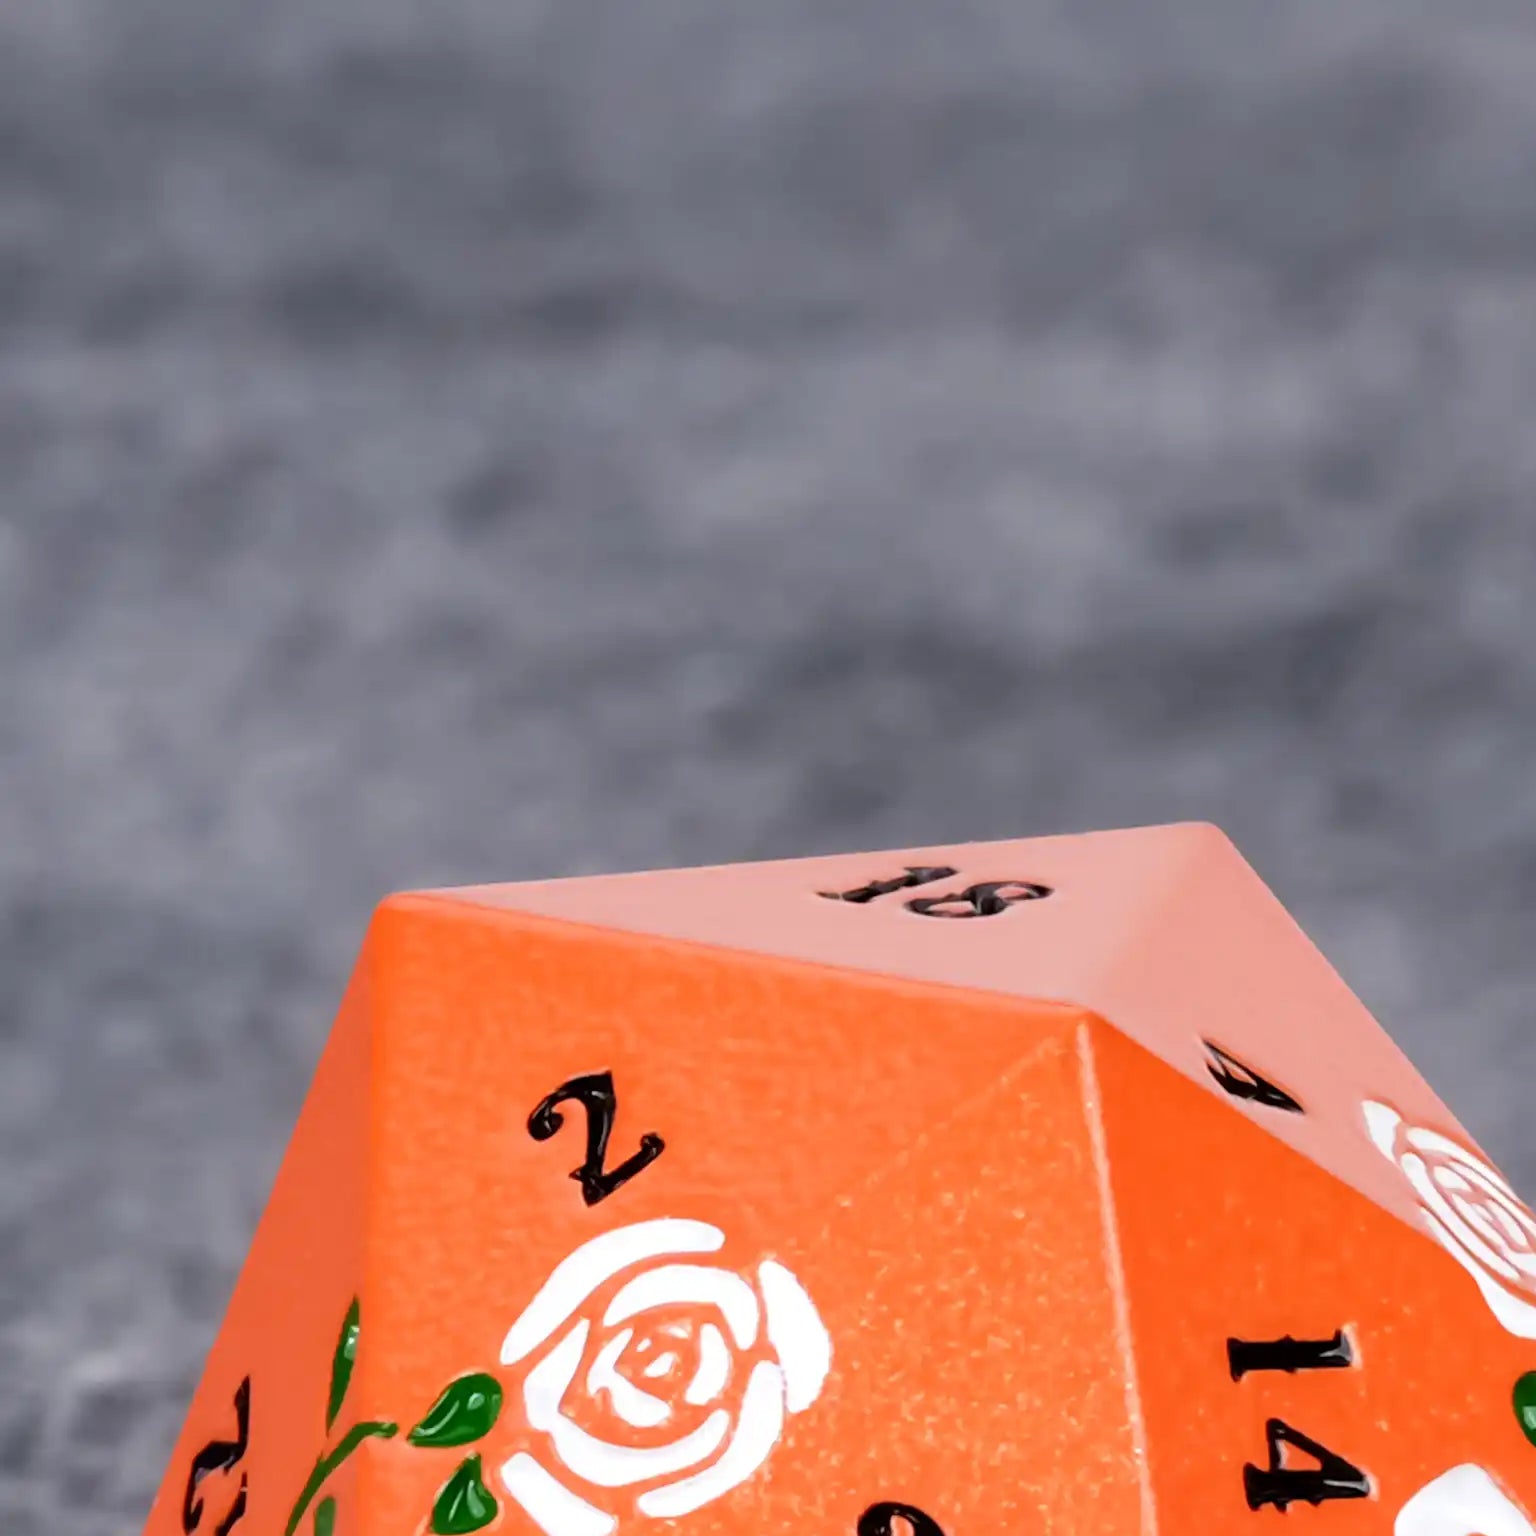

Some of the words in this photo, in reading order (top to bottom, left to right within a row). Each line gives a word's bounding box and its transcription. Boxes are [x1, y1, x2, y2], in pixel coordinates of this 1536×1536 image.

[528, 1071, 665, 1206] 2
[1202, 1039, 1304, 1113] 4
[1227, 1328, 1370, 1513] 14
